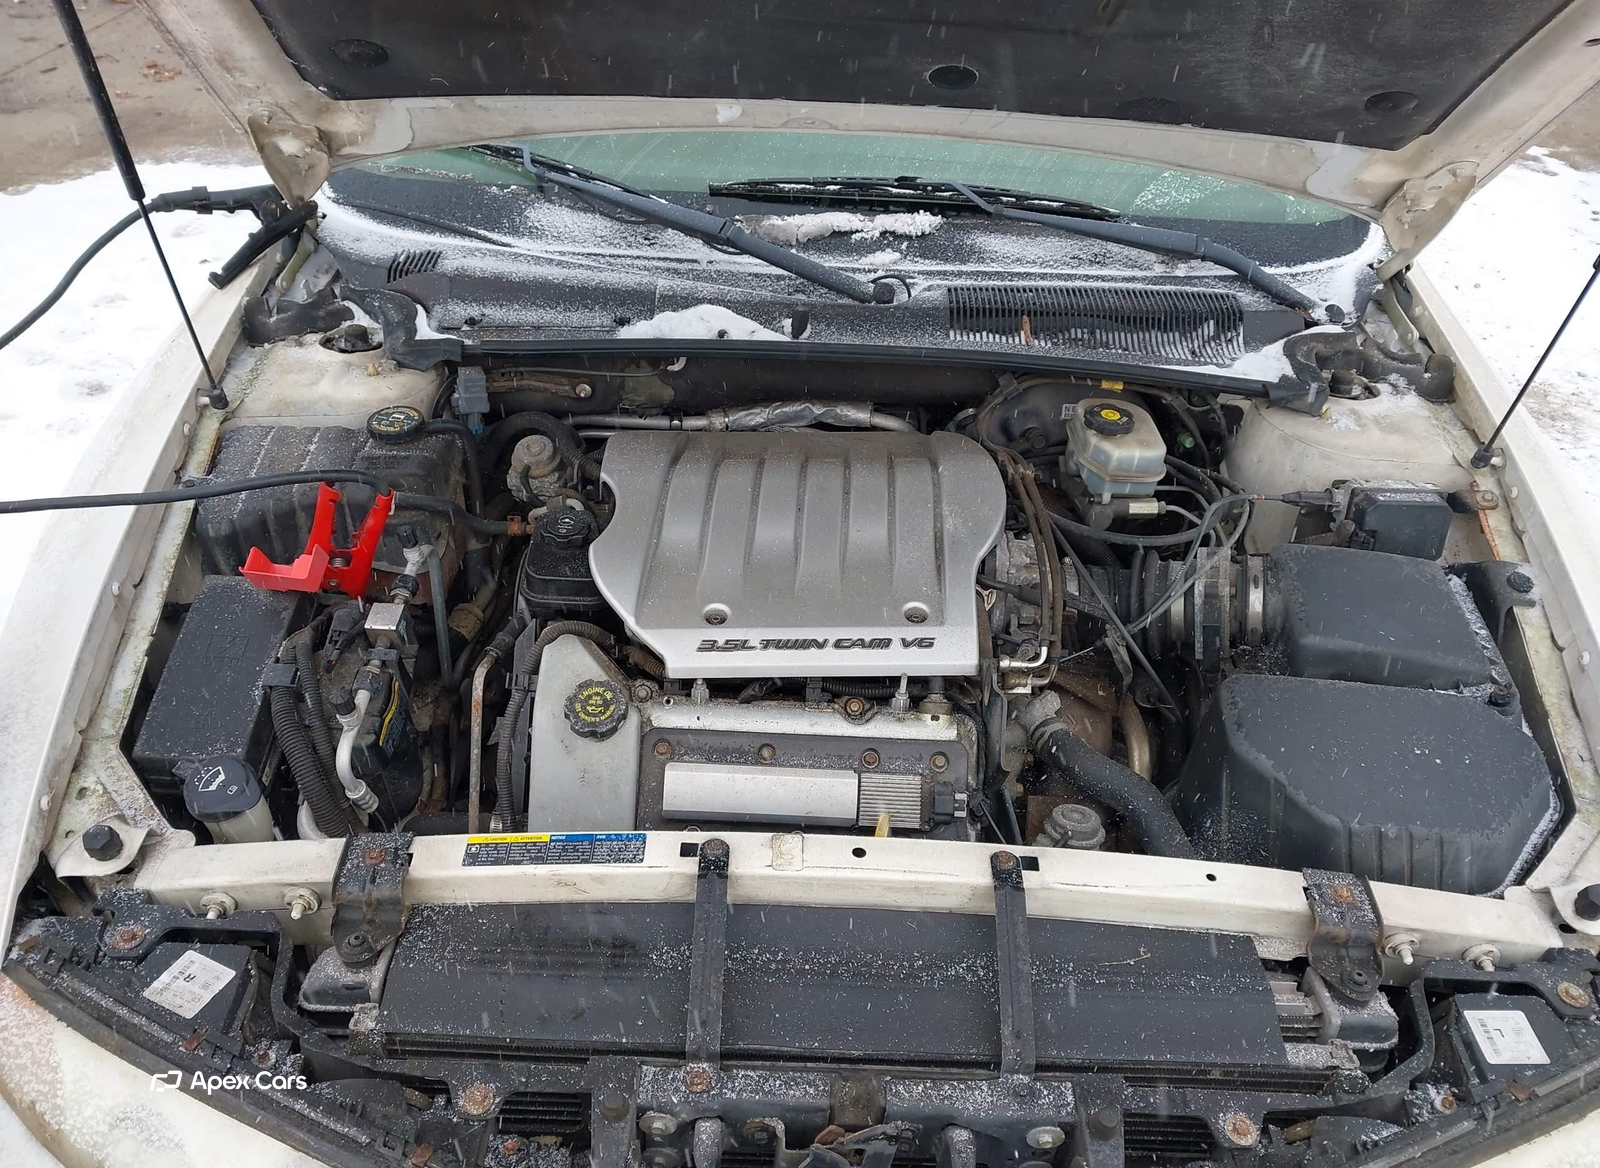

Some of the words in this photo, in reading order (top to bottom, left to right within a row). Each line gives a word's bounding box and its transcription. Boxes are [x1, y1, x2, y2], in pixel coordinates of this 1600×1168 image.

[696, 639, 757, 653] 3.5L
[758, 638, 830, 651] TWIN
[832, 637, 893, 651] CAM
[898, 637, 938, 650] V6
[578, 686, 605, 700] ENGINE
[604, 690, 613, 701] OIL
